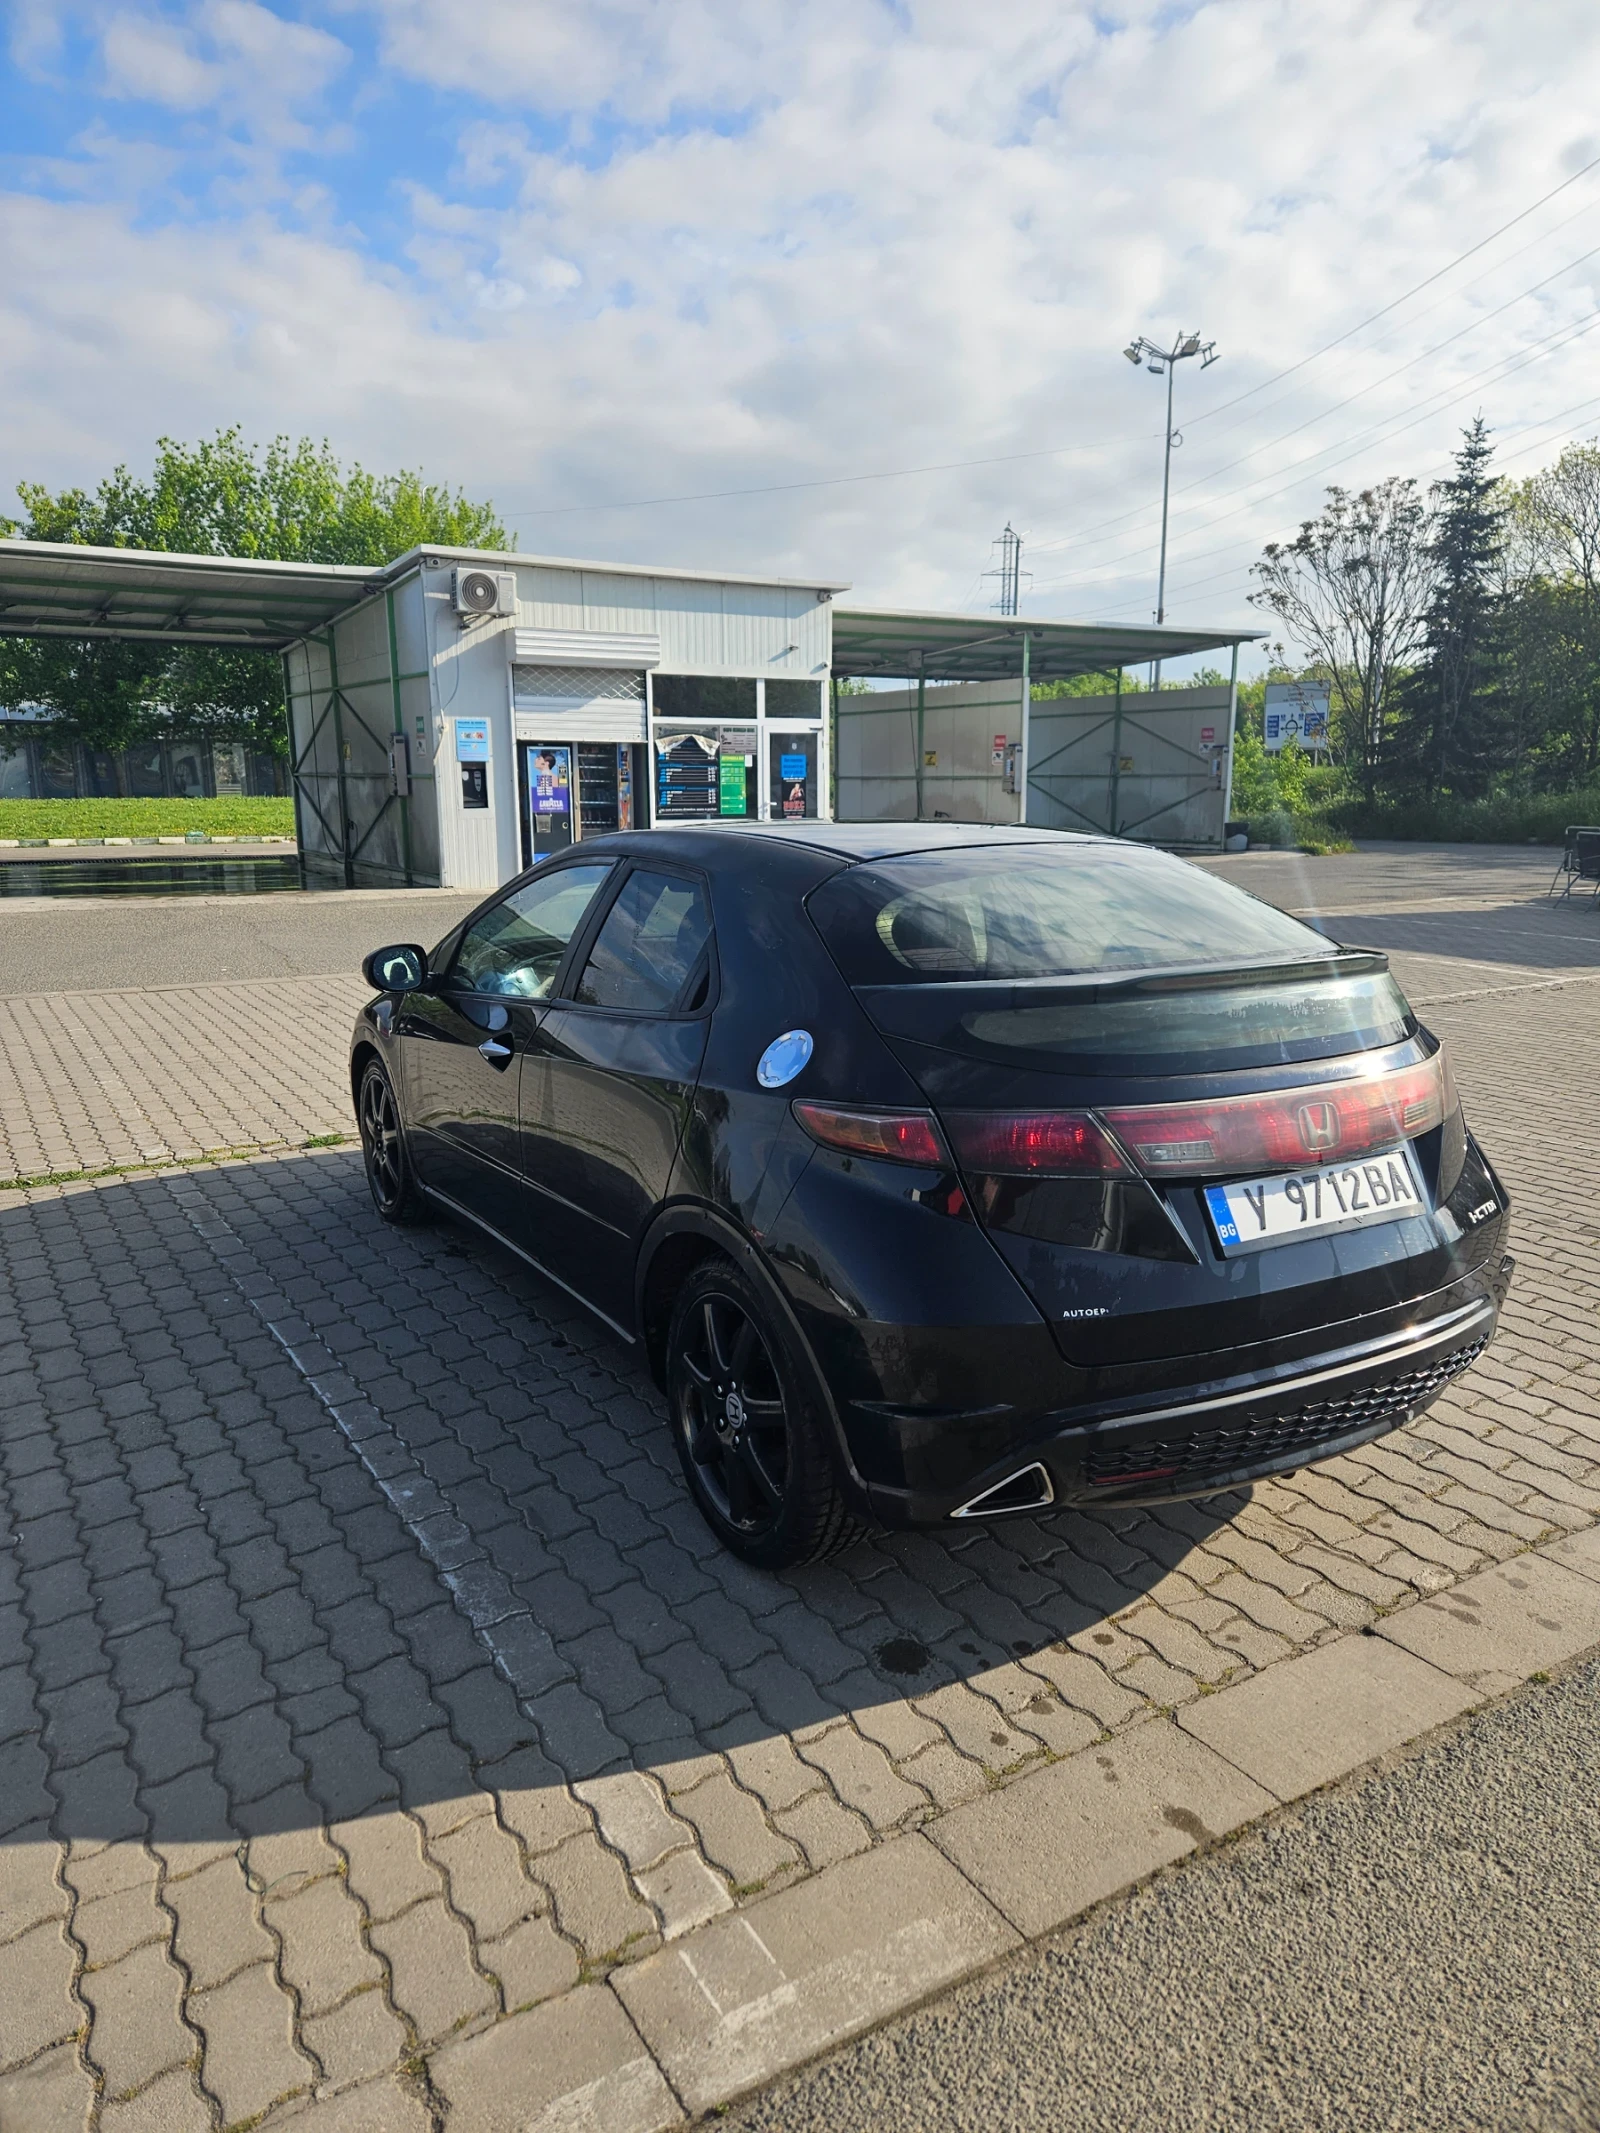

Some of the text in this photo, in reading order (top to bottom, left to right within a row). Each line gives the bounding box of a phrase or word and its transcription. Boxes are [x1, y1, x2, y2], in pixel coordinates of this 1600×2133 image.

[1243, 1161, 1412, 1231] Y 9712BA
[1219, 1223, 1236, 1239] BG
